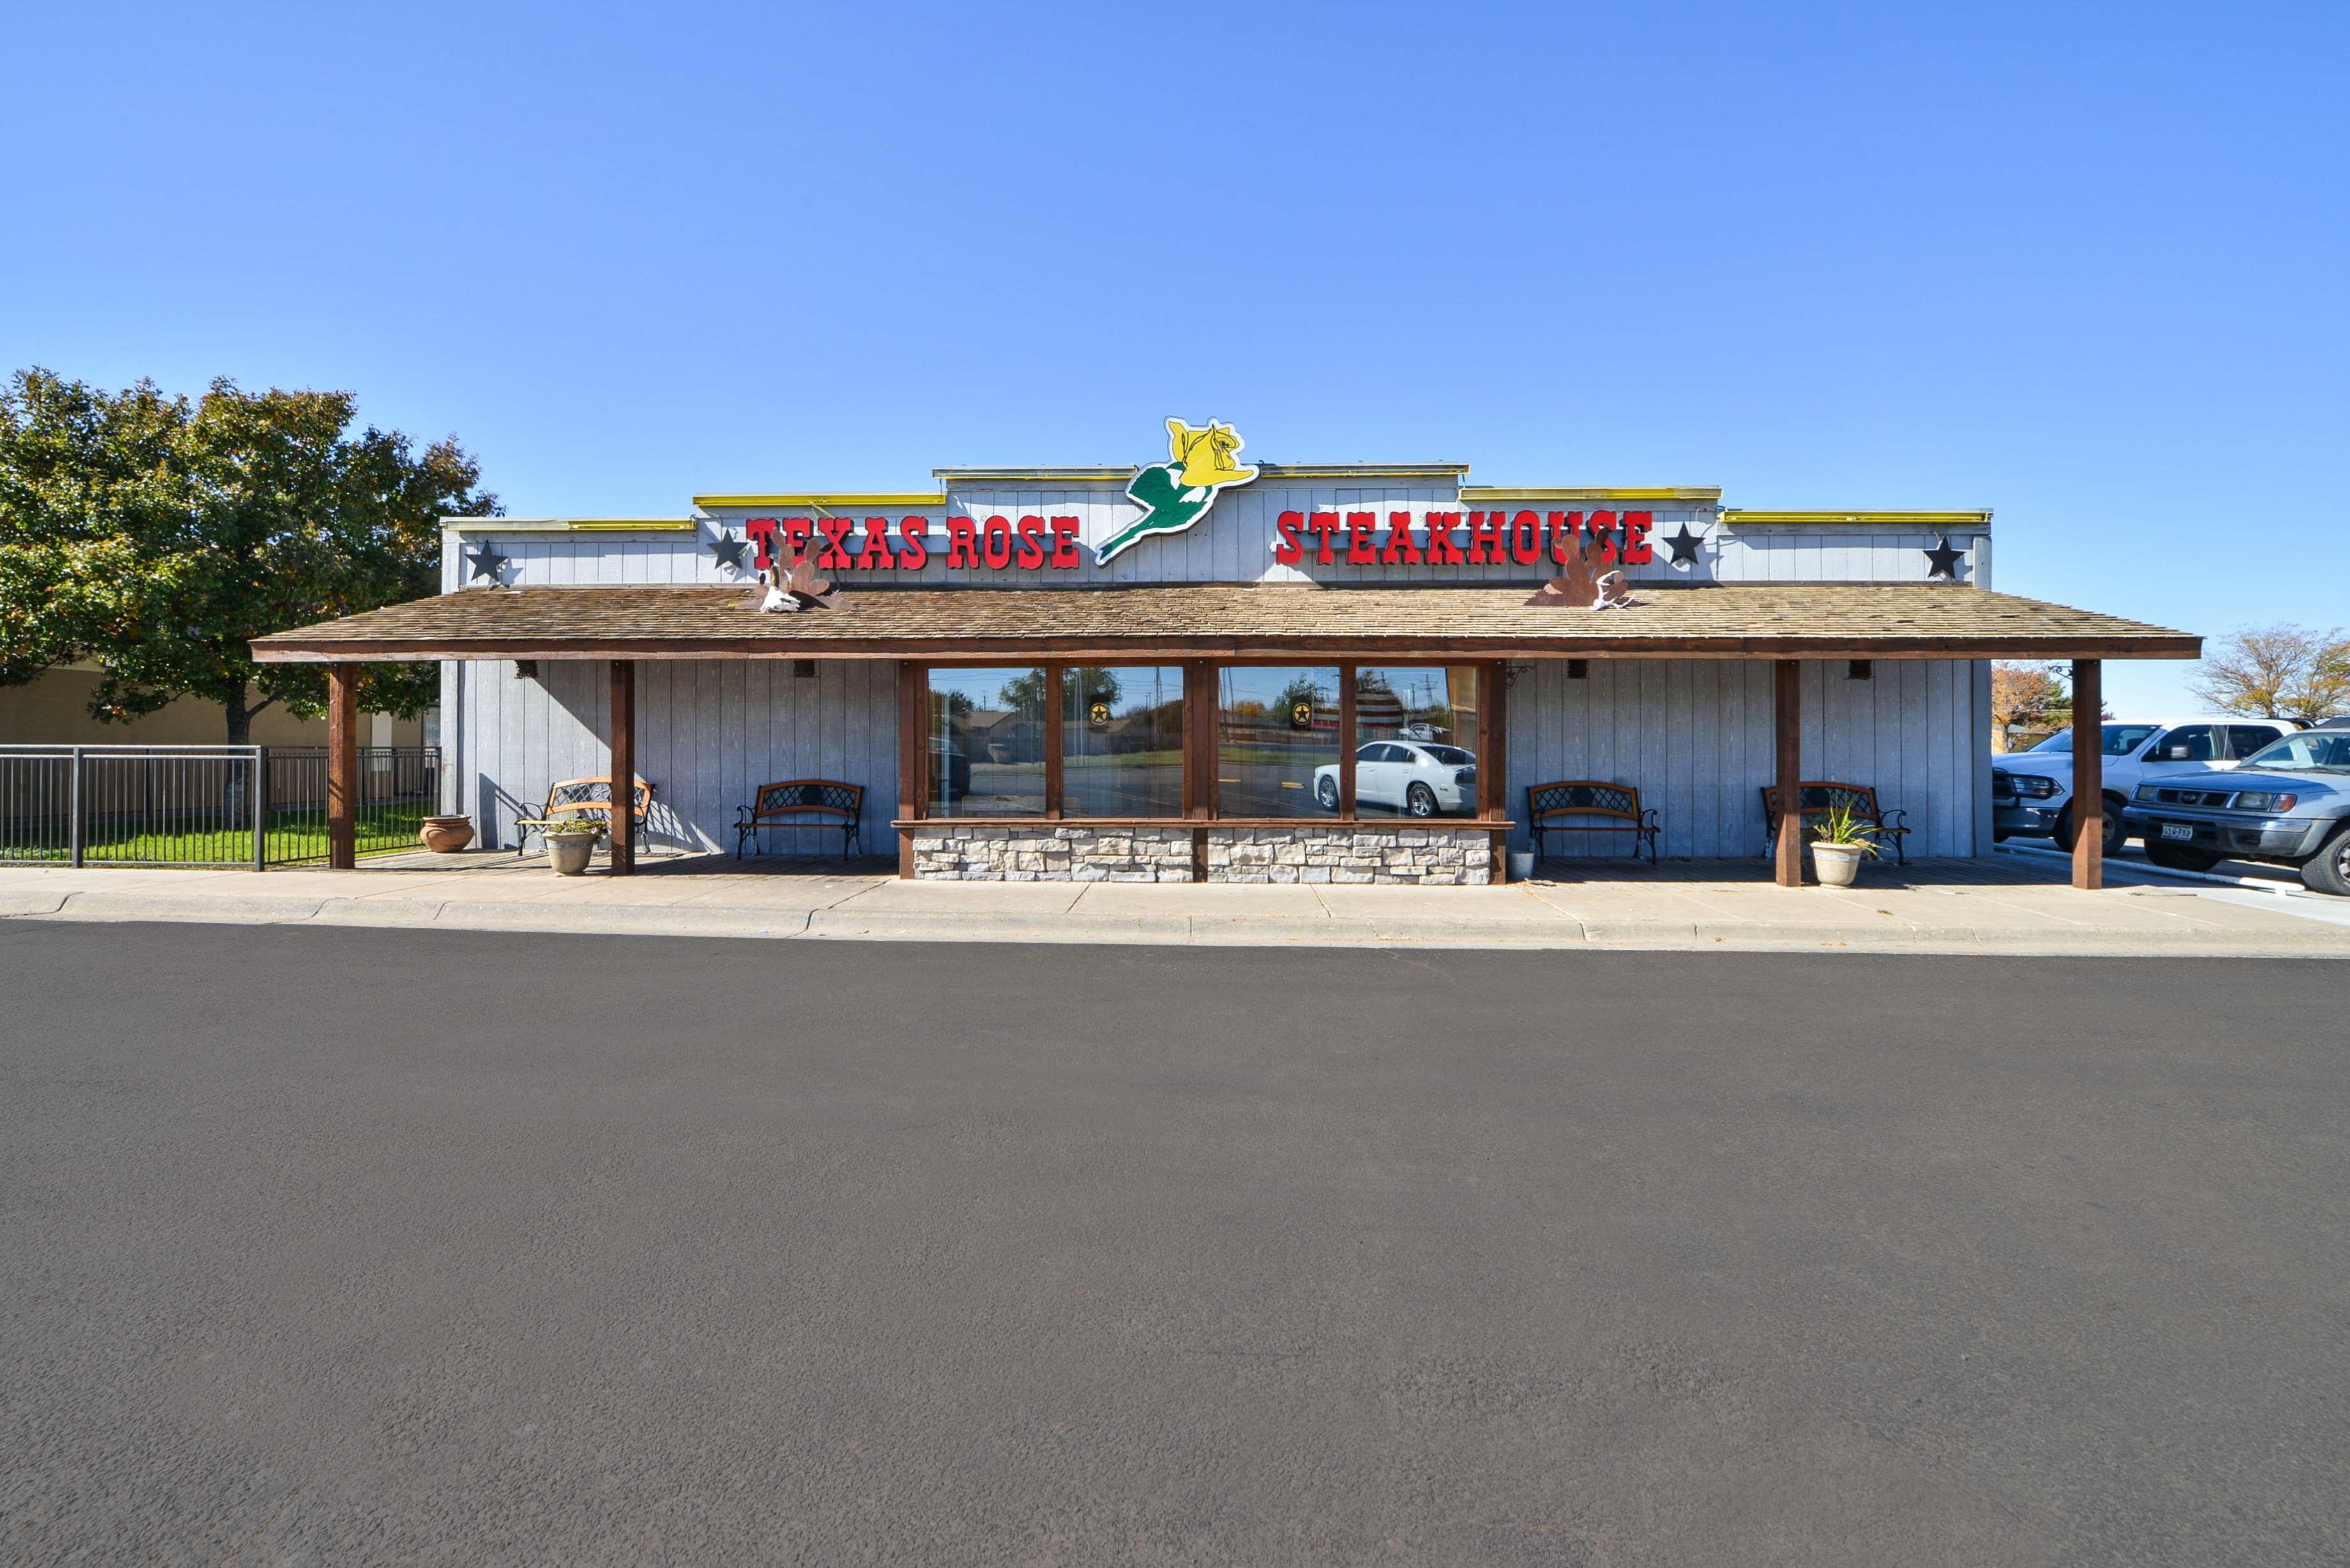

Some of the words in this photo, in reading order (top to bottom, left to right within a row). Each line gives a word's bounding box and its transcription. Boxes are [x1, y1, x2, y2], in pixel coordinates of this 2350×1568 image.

[746, 516, 928, 569] TEXAS
[946, 515, 1080, 569] ROSE
[1276, 510, 1653, 565] STEAKHOUSE
